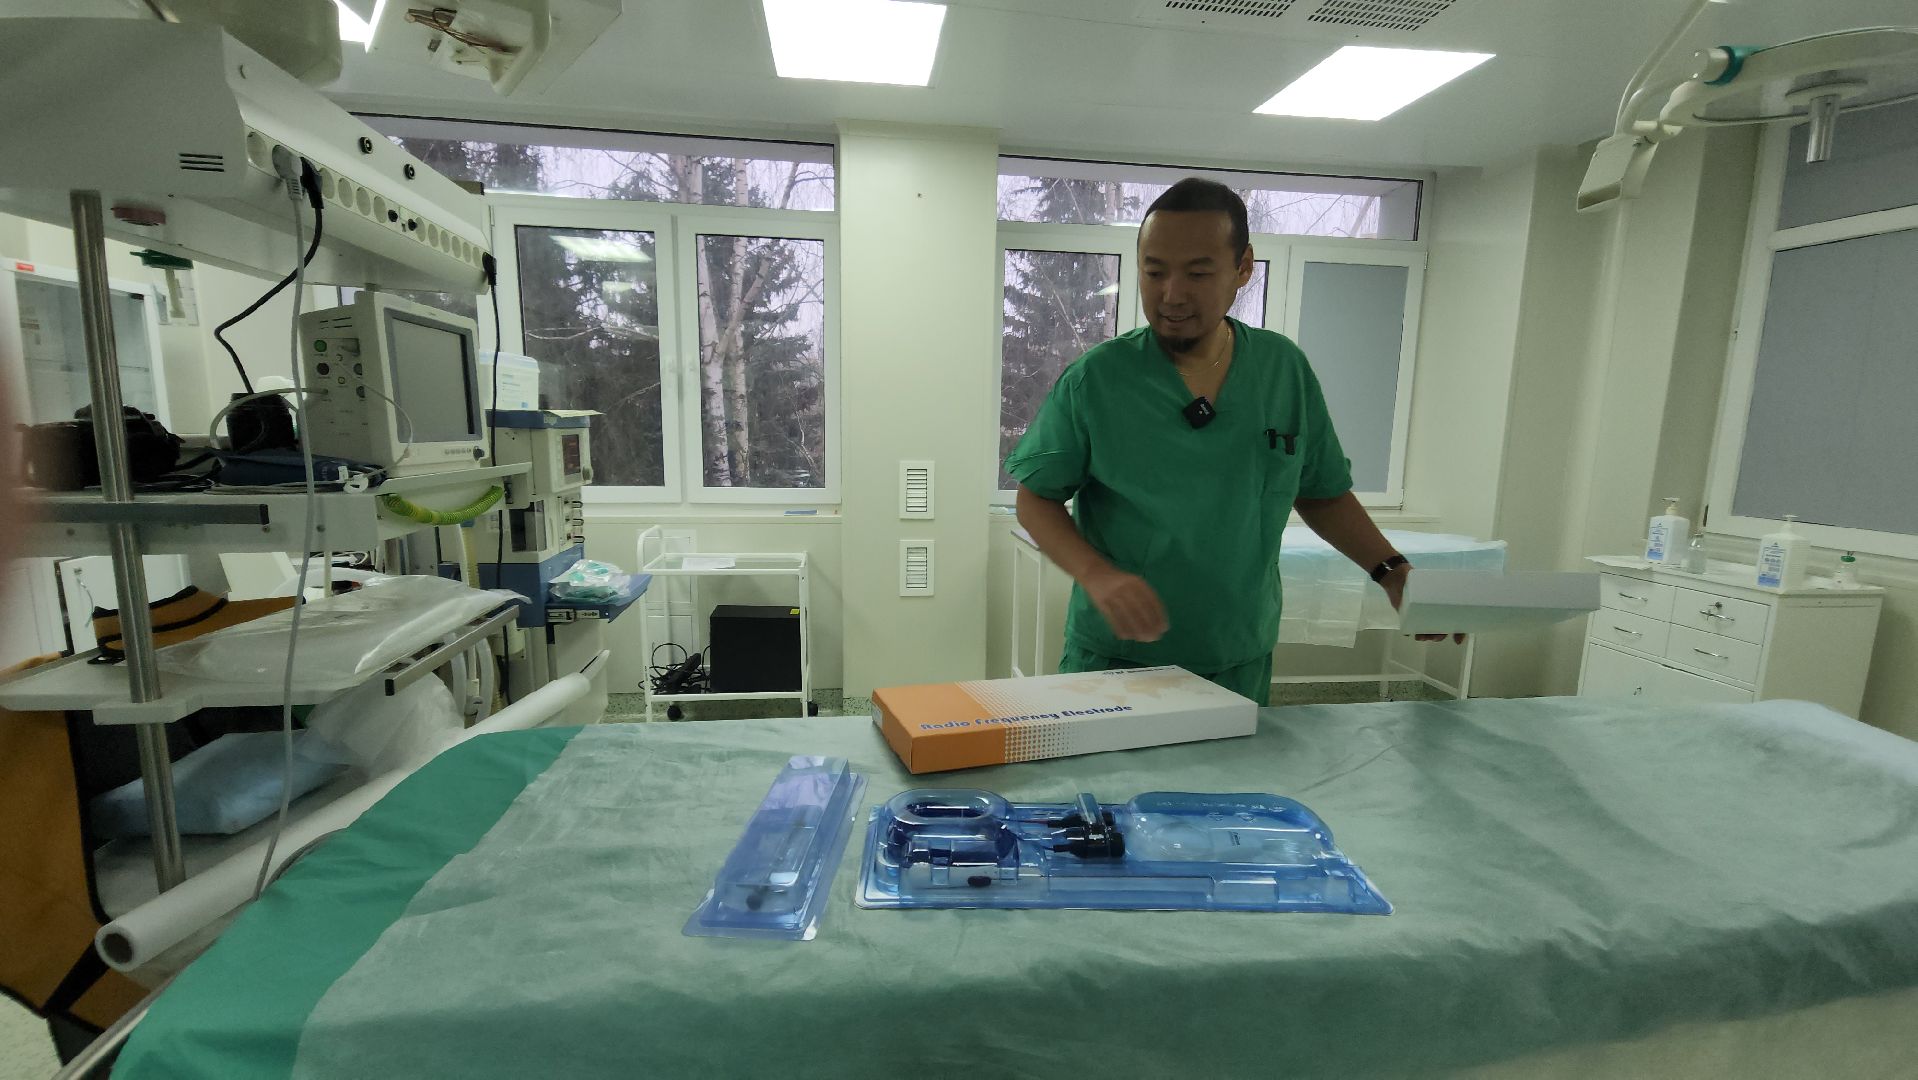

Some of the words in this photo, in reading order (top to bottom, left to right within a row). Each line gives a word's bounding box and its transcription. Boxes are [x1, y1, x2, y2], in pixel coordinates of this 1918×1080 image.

[920, 720, 970, 730] Radio
[974, 711, 1060, 725] Frequency
[1062, 705, 1134, 718] Electrode
